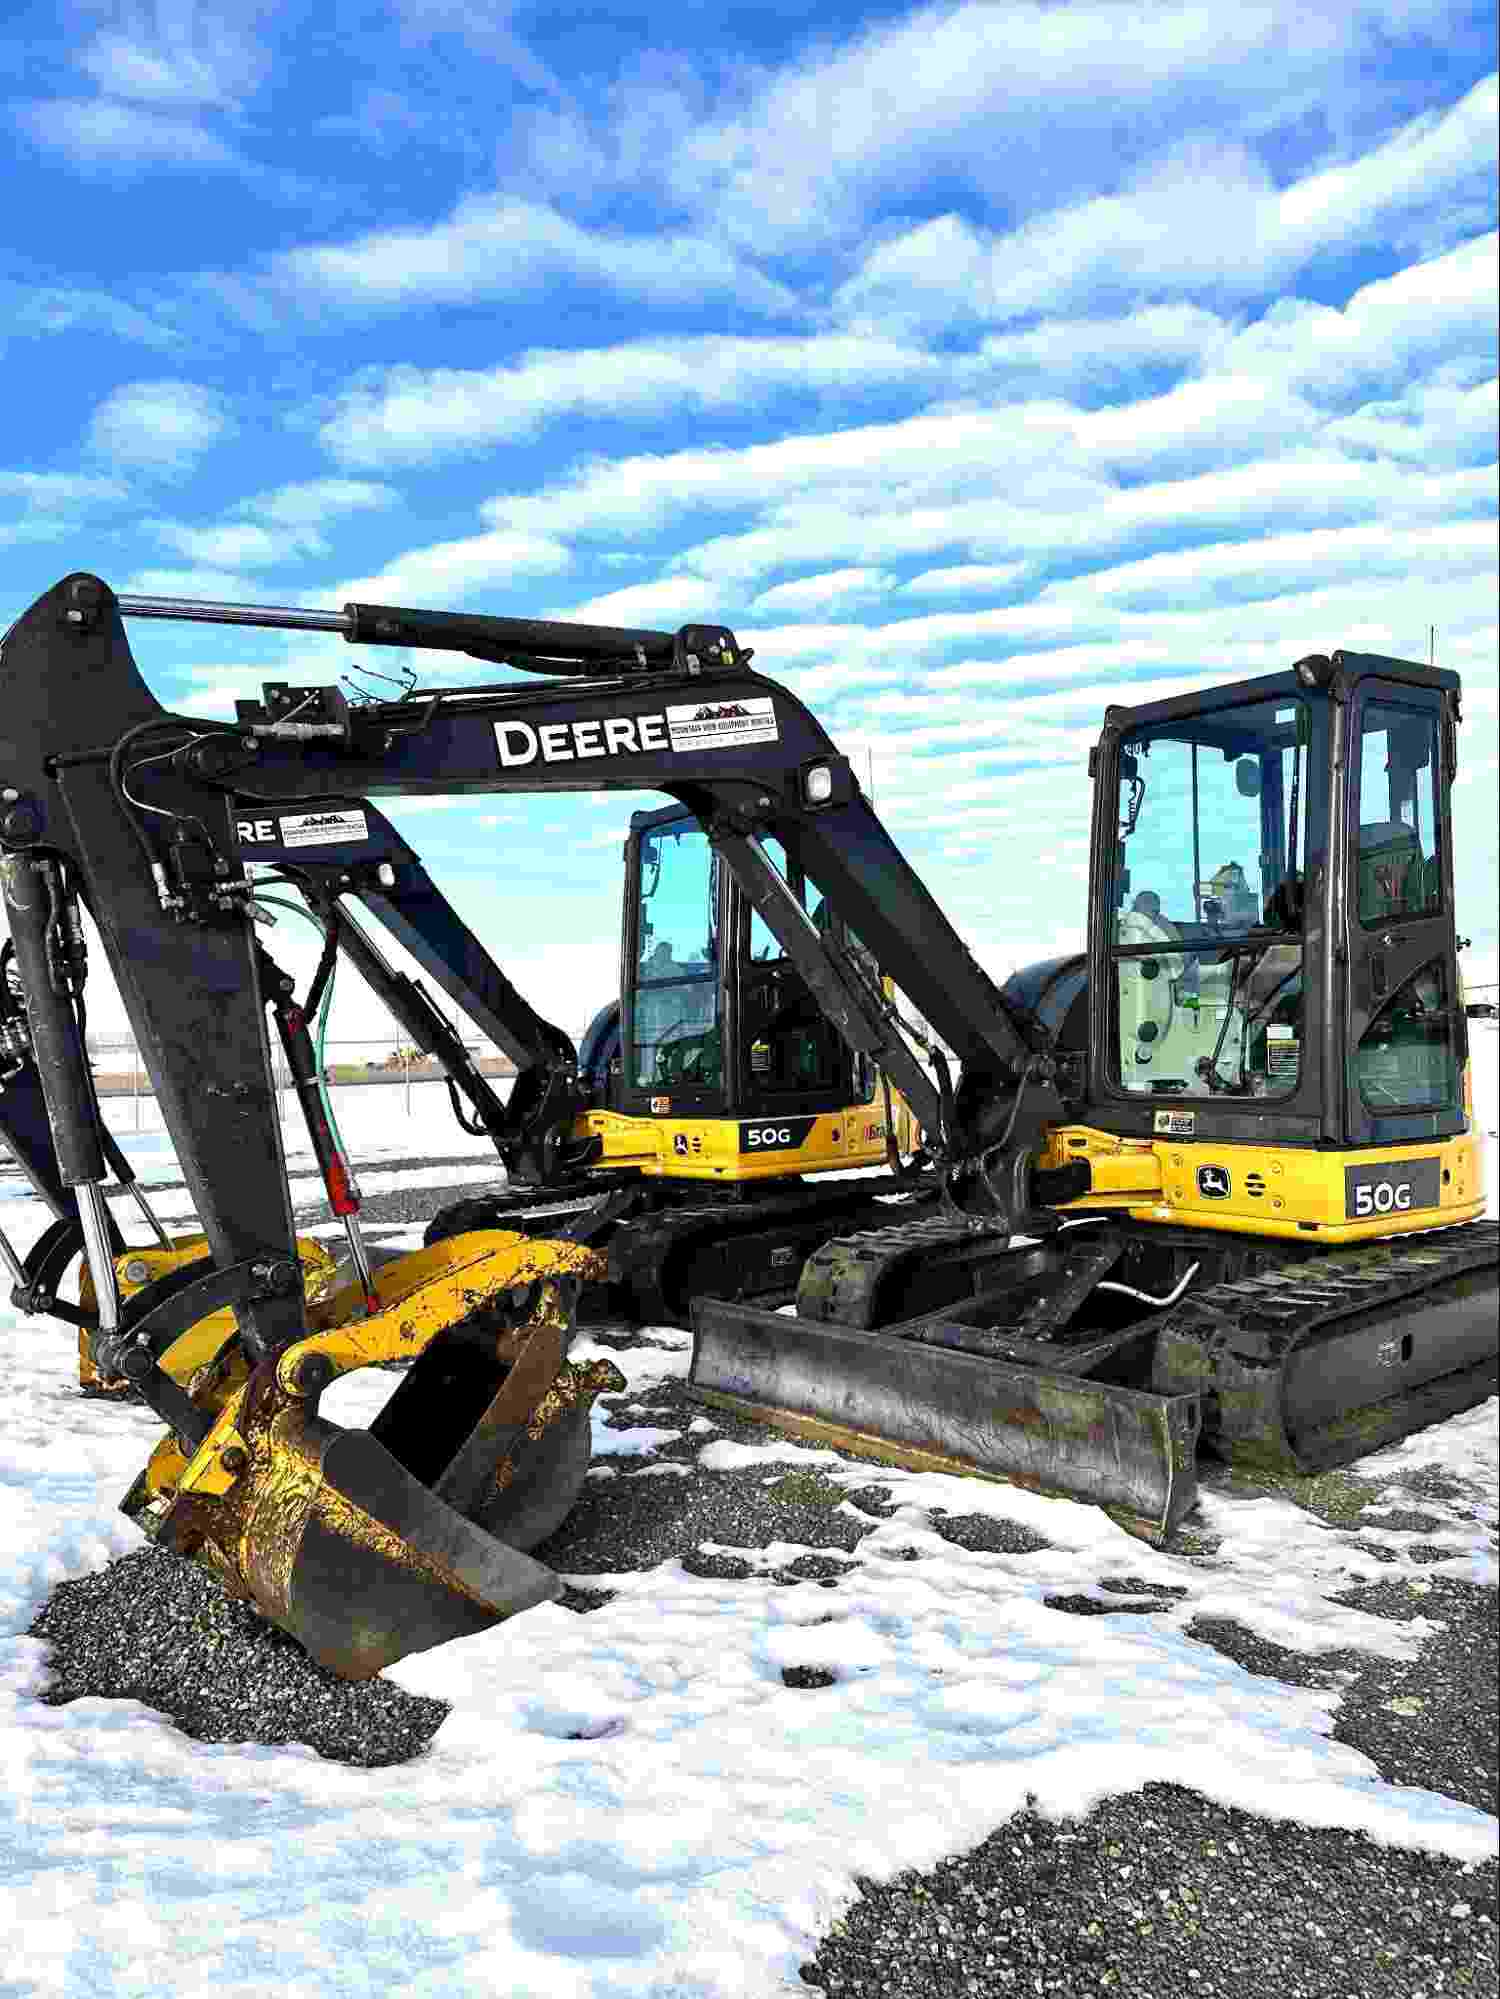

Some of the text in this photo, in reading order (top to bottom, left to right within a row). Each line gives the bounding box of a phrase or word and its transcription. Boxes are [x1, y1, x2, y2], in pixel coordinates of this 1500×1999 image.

[493, 714, 669, 768] DEERE
[747, 1128, 791, 1146] 50G
[1354, 1182, 1412, 1216] 50G
